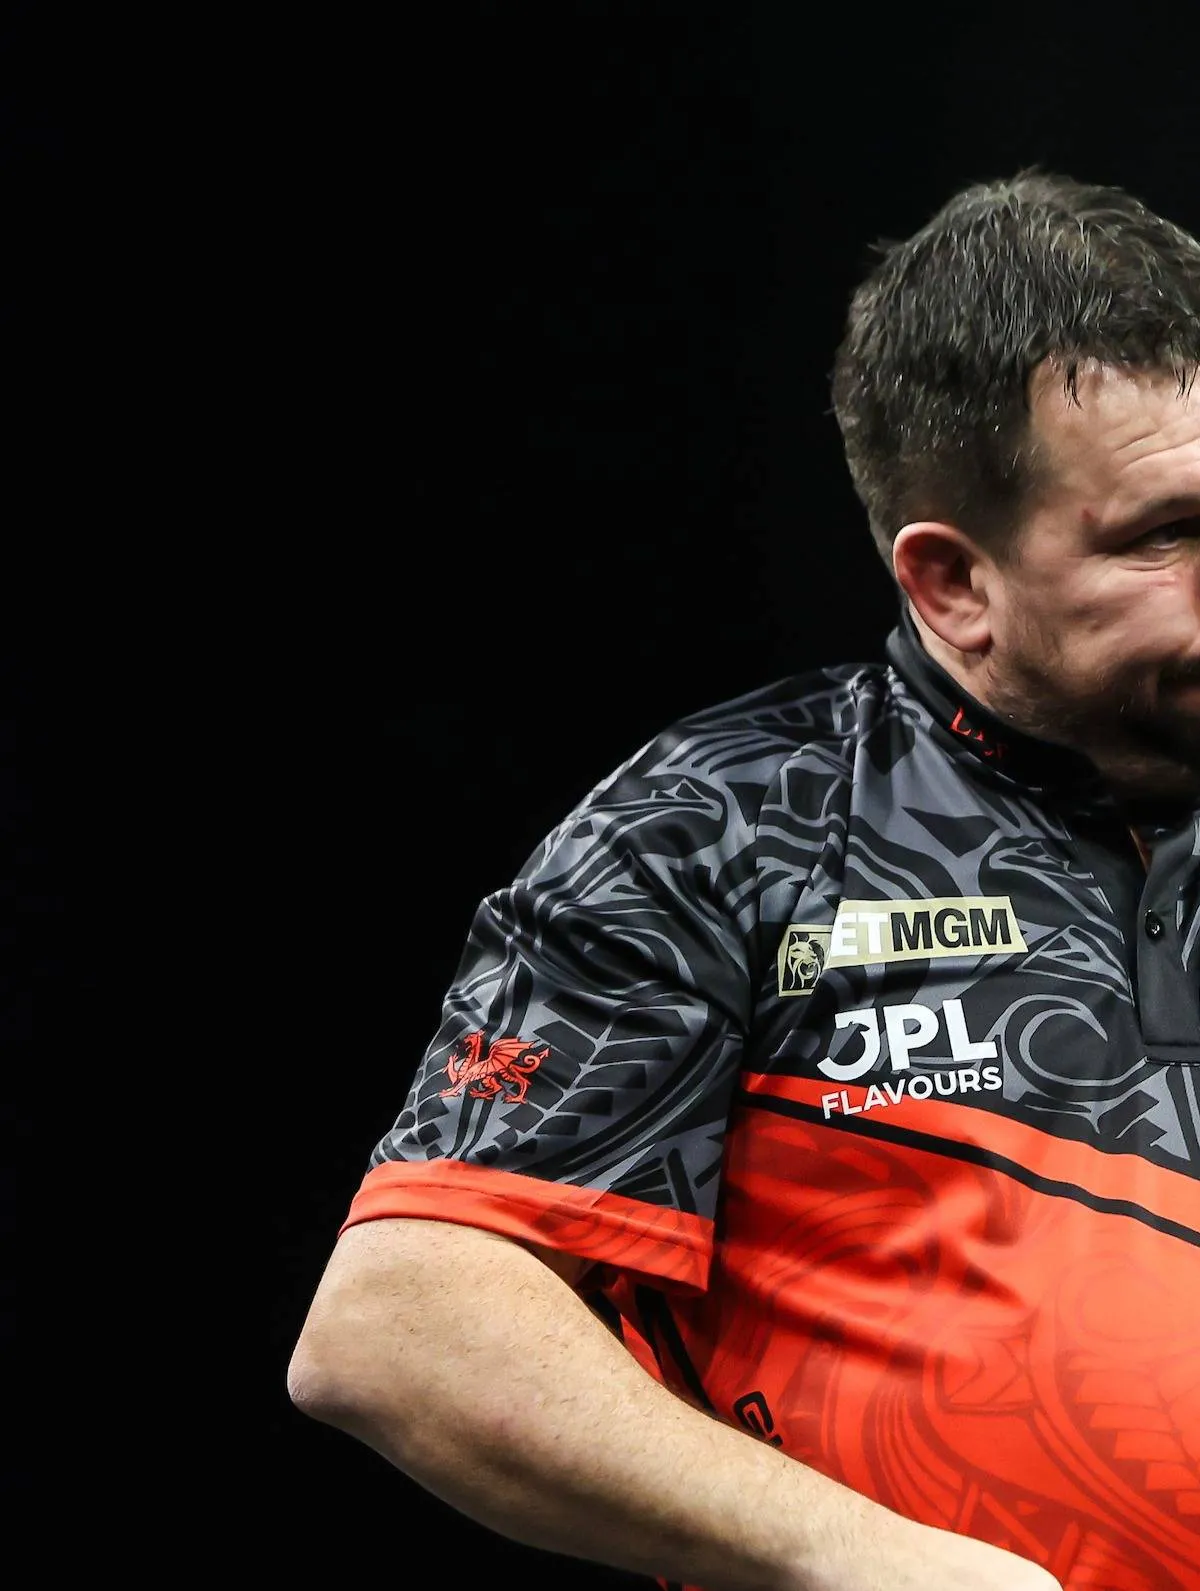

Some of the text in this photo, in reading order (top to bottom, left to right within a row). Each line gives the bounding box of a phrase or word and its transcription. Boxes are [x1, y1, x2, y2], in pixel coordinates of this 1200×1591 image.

[830, 908, 1012, 957] ETMGM
[817, 999, 998, 1081] JPL
[821, 1066, 1002, 1120] FLAVOURS
